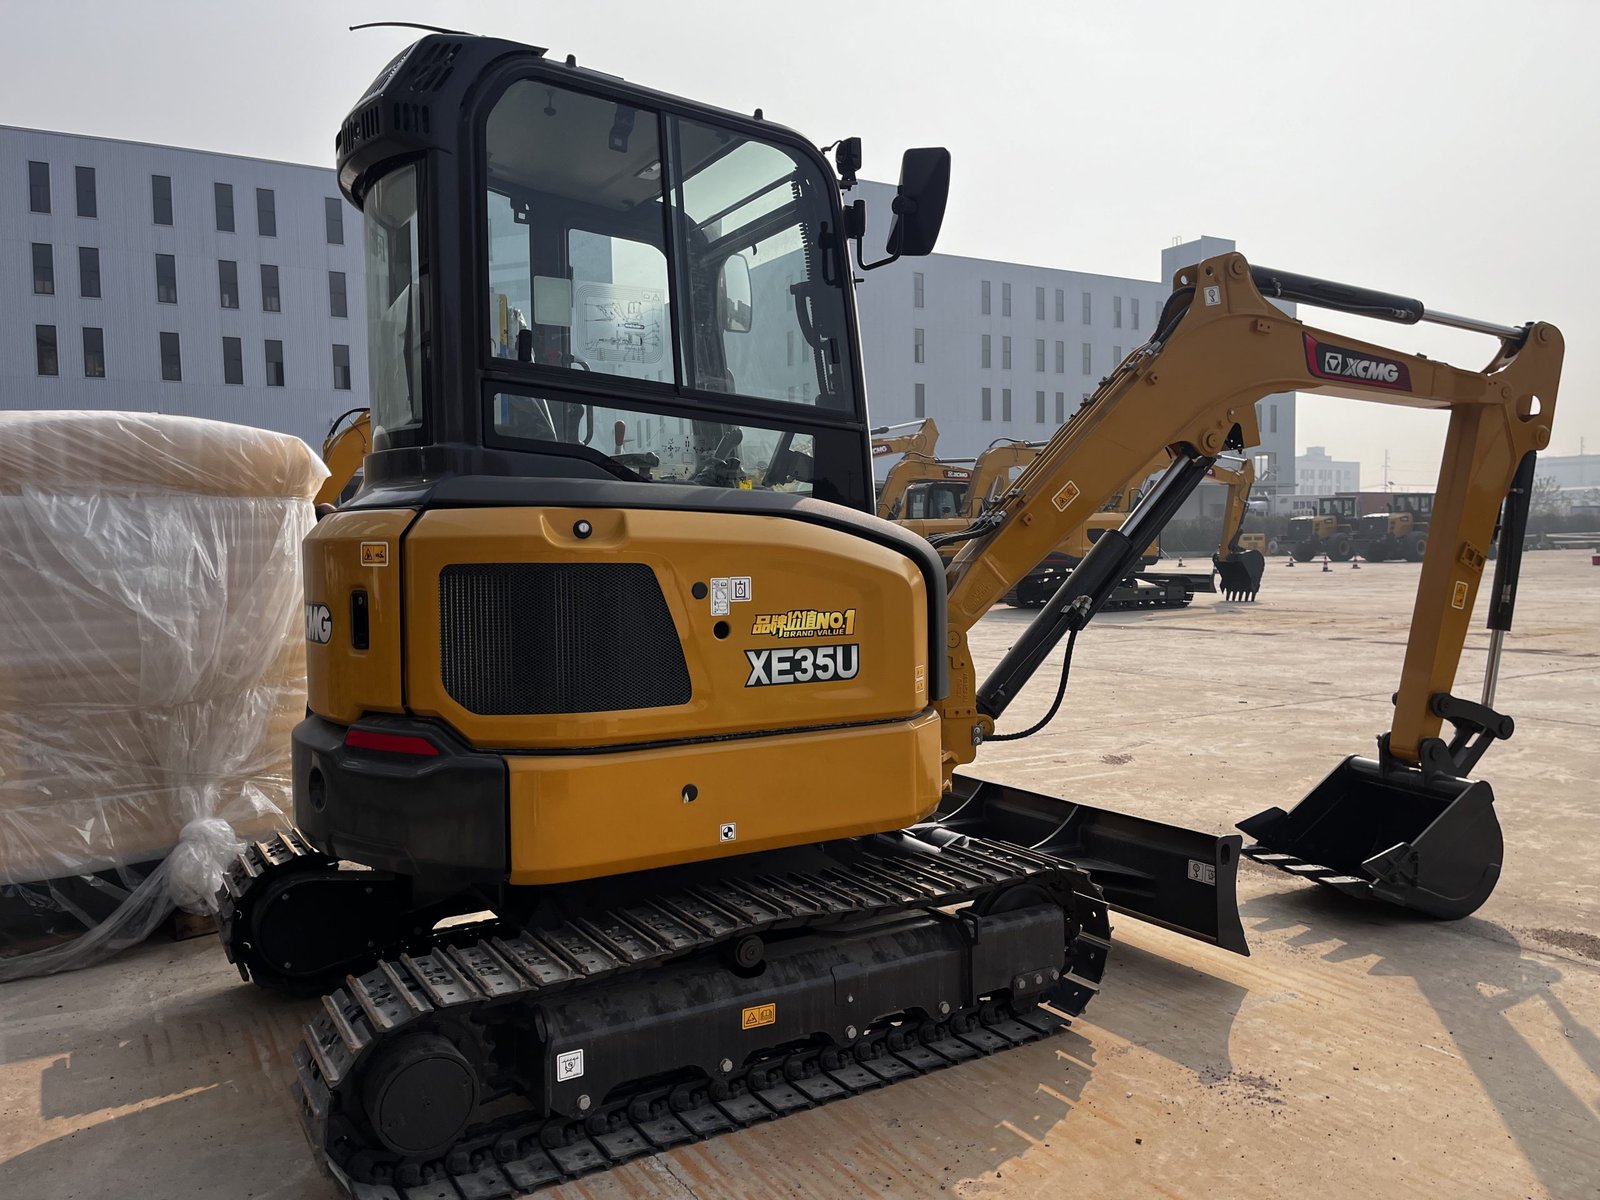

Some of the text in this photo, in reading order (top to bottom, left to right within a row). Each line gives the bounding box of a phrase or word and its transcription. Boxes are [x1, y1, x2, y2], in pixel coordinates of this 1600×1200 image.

[1343, 358, 1399, 383] XCMG
[783, 630, 813, 638] BRAND
[747, 645, 858, 686] XE35U
